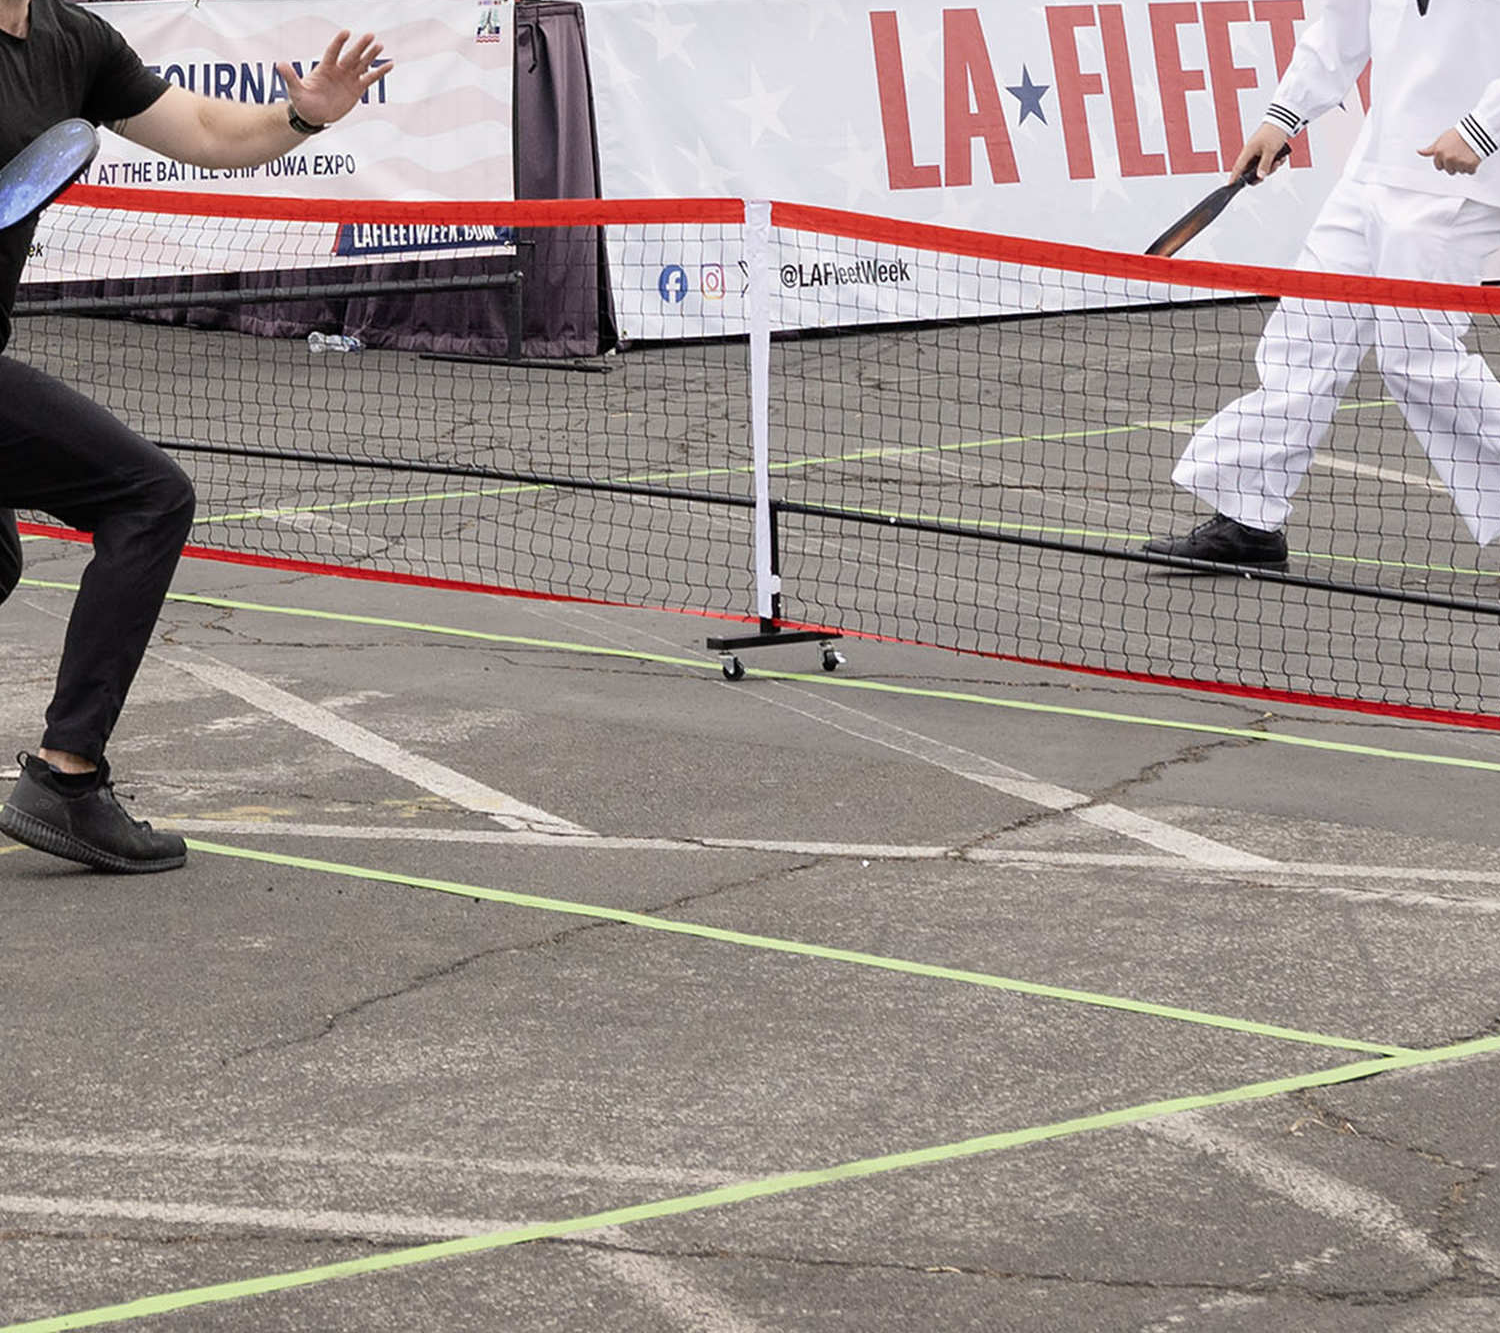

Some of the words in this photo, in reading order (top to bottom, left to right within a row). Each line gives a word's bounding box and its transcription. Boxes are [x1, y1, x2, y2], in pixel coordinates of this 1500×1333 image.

[870, 8, 1020, 190] LA
[1046, 0, 1313, 180] FLEET
[98, 164, 118, 185] AT
[122, 161, 152, 184] THE
[157, 161, 219, 183] BATTLE
[265, 156, 308, 178] IOWA
[313, 154, 356, 175] EXPO
[780, 258, 911, 289] @LAFleetWeek
